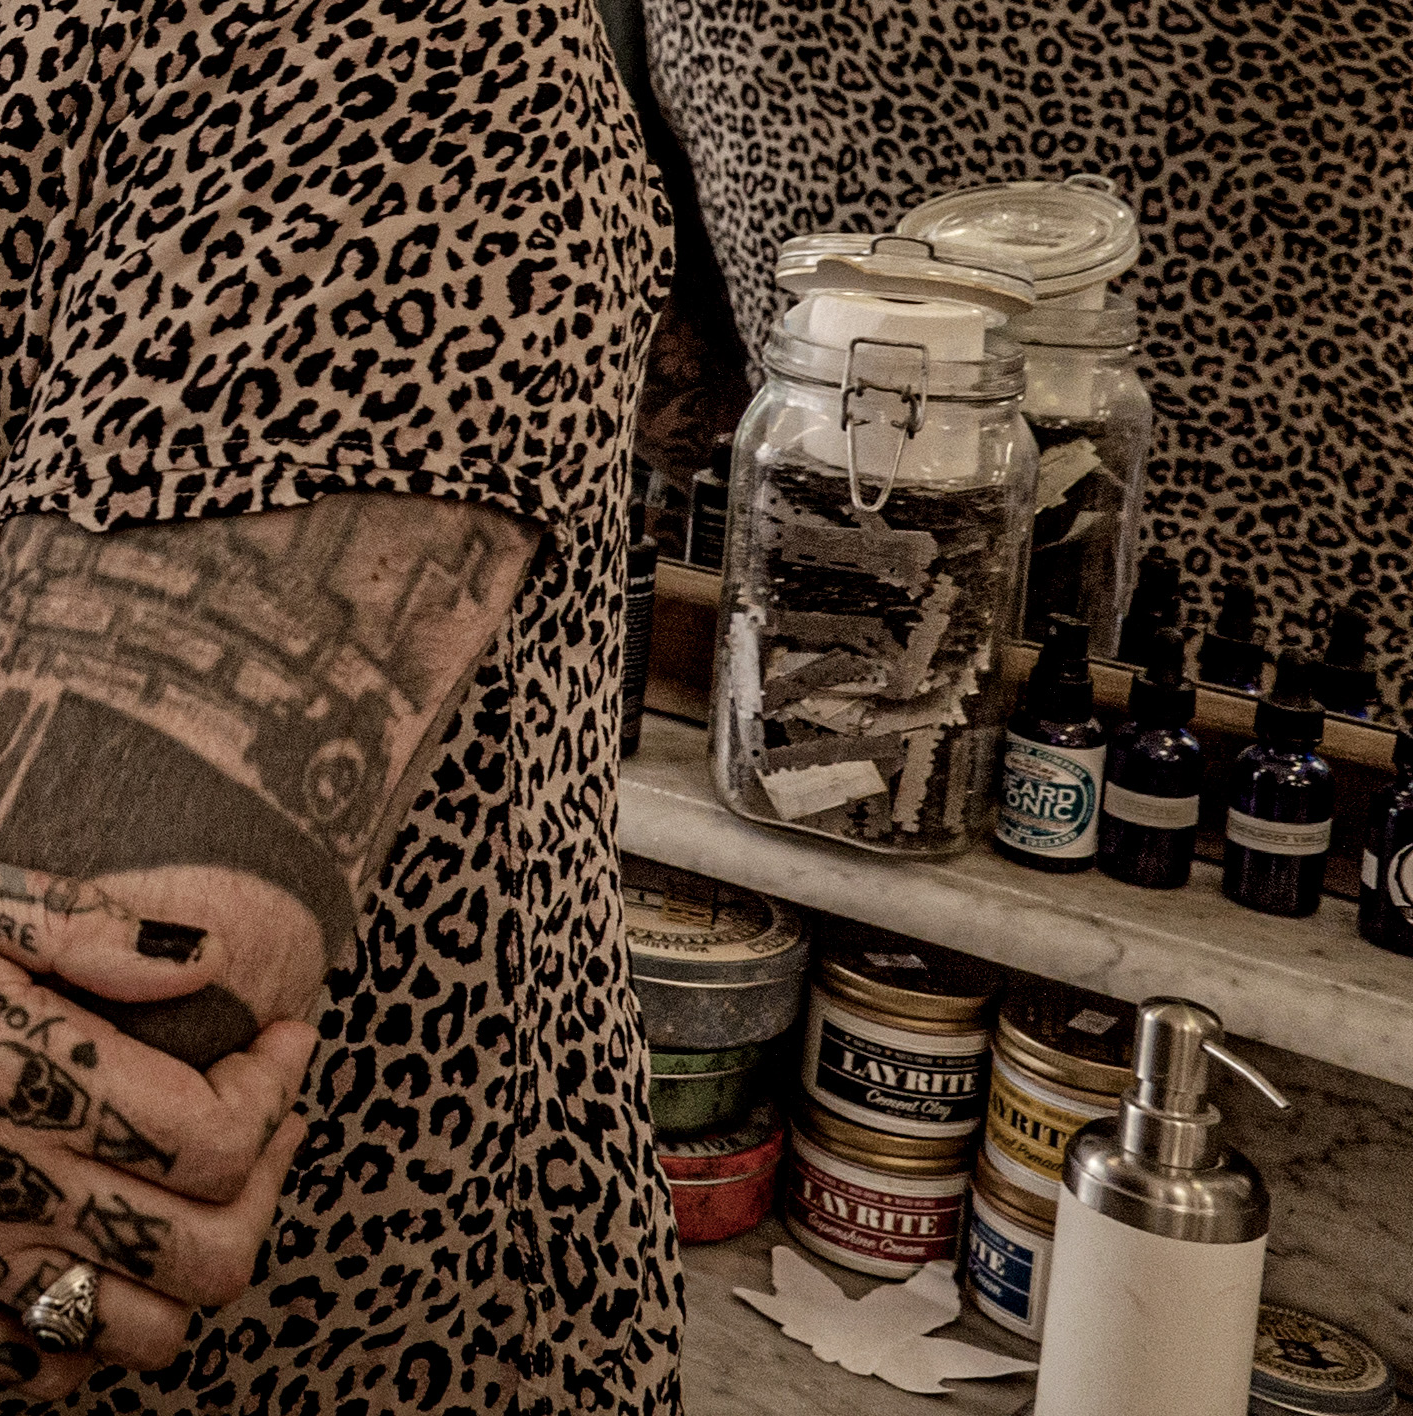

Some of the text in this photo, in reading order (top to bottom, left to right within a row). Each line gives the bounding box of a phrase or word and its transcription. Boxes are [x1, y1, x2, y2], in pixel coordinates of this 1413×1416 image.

[1005, 790, 1073, 820] ONIC
[841, 1050, 979, 1095] LAYRITE
[865, 1089, 920, 1113] Cement
[922, 1099, 954, 1123] Clay
[1017, 1141, 1064, 1173] Pomad
[803, 1180, 939, 1235] LAYRITE
